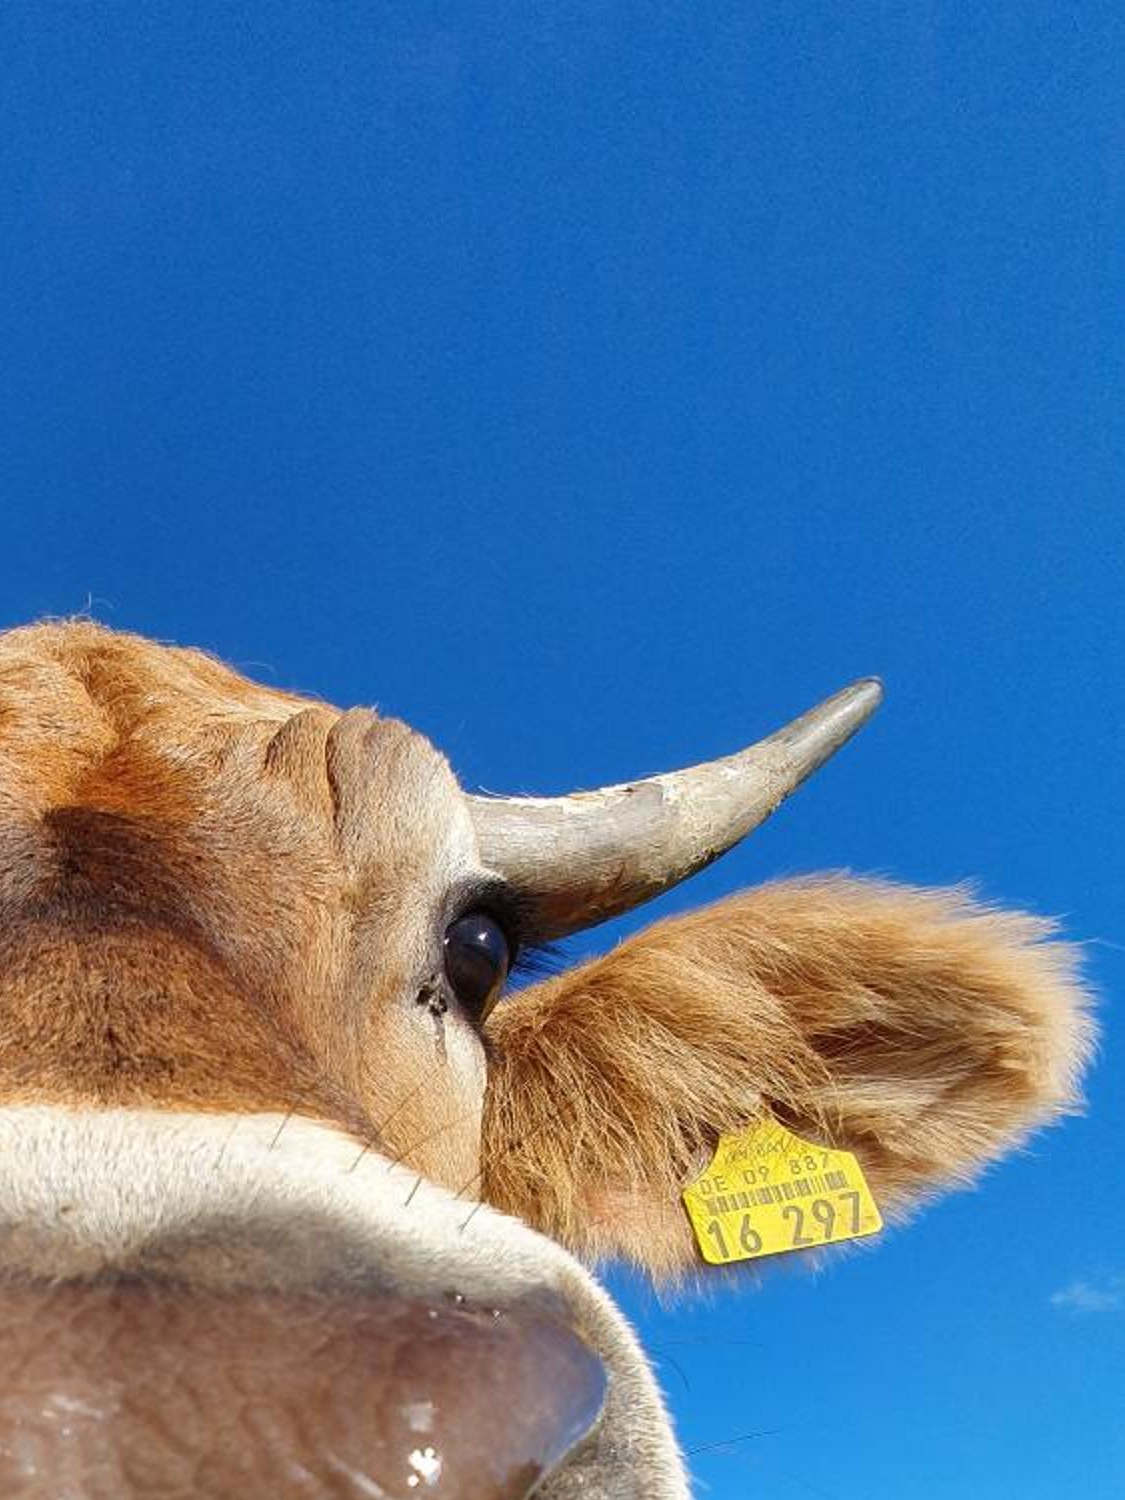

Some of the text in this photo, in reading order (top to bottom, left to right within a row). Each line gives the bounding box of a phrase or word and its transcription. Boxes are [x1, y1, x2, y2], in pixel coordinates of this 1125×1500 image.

[700, 1175, 728, 1195] DE
[742, 1165, 770, 1185] 09
[706, 1191, 861, 1259] 16 297
